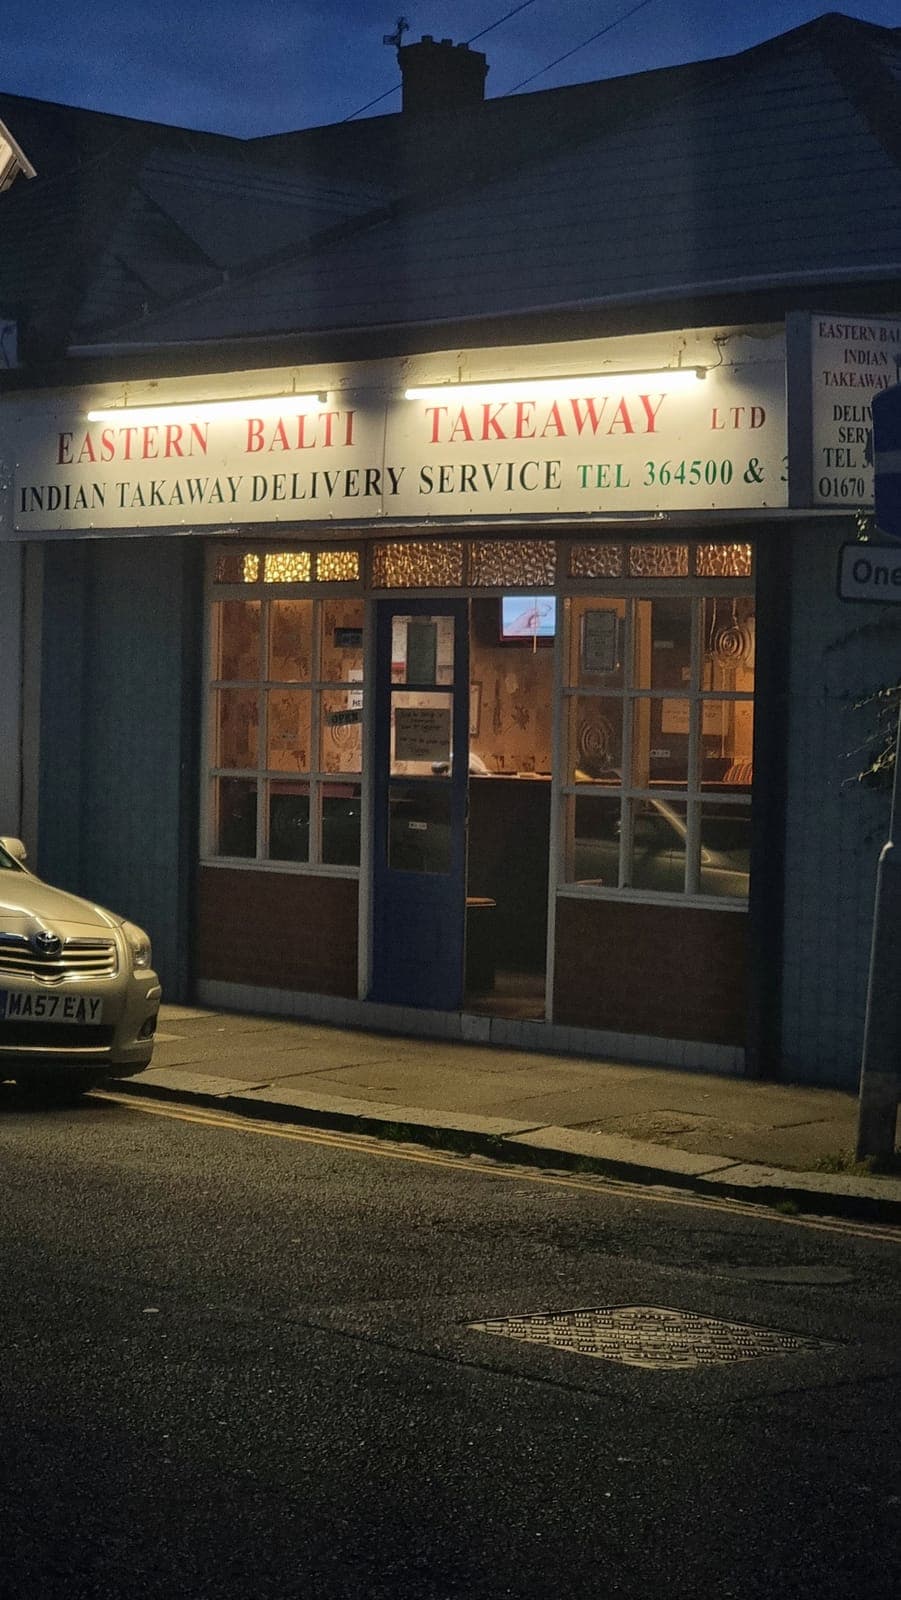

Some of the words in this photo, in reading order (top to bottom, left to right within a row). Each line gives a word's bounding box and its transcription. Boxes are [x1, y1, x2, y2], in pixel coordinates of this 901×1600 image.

[819, 321, 876, 341] EASTERN
[844, 348, 888, 366] INDIAN
[822, 371, 891, 389] TAKEAWAY
[56, 422, 209, 465] EASTERN
[245, 410, 357, 453] BALTI
[424, 393, 666, 444] TAKEAWAY
[711, 406, 766, 431] LTD
[823, 447, 857, 468] TEL
[20, 482, 107, 513] INDIAN
[116, 474, 244, 508] TAKAWAY
[251, 466, 408, 502] DELIVERY
[419, 460, 562, 495] SERVICE
[576, 463, 631, 488] TEL
[643, 459, 734, 487] 364500
[743, 457, 767, 484] &
[852, 558, 901, 587] One
[9, 994, 60, 1016] MA57
[63, 997, 100, 1019] EAY
